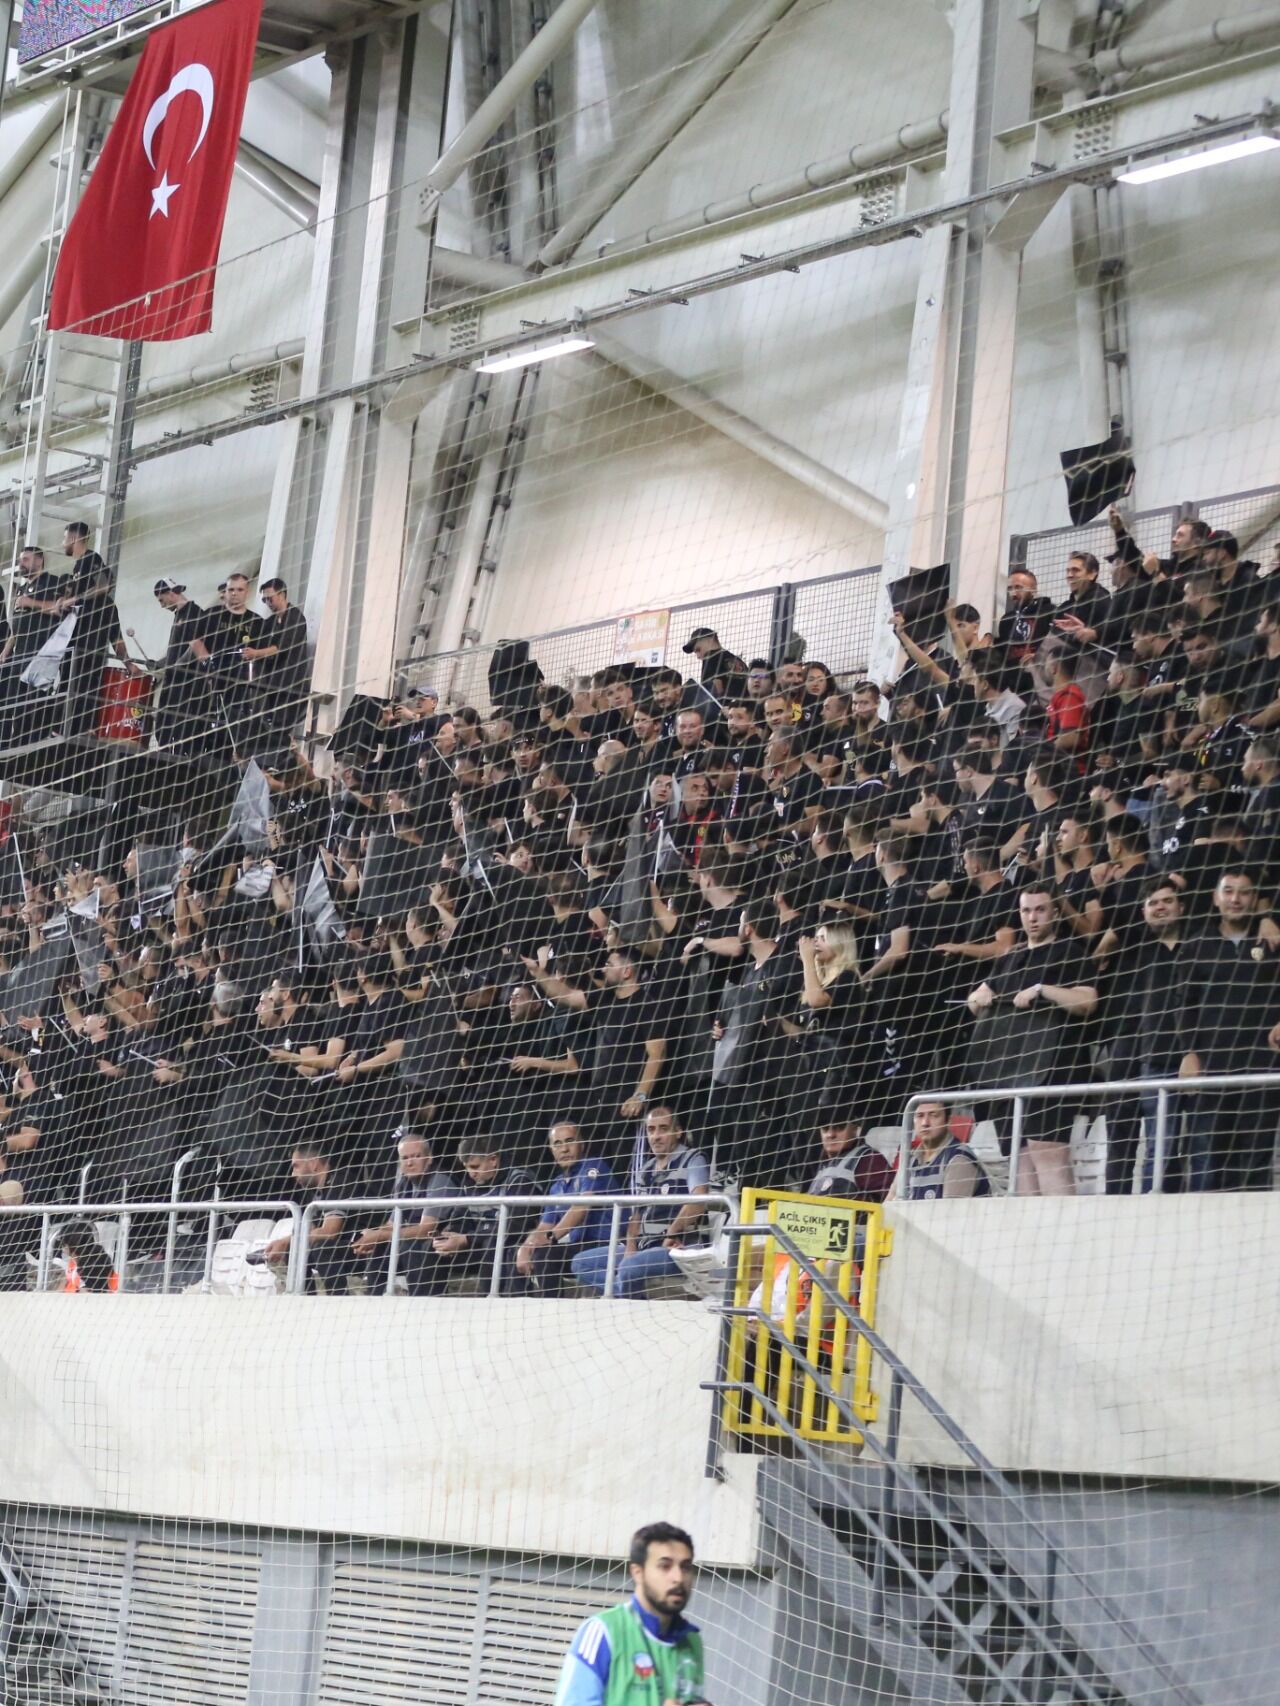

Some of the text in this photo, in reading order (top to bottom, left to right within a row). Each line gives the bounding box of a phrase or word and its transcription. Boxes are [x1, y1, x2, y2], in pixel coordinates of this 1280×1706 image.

[779, 1211, 827, 1227] ACİL ÇIKIŞ
[786, 1224, 817, 1235] KAPISI
